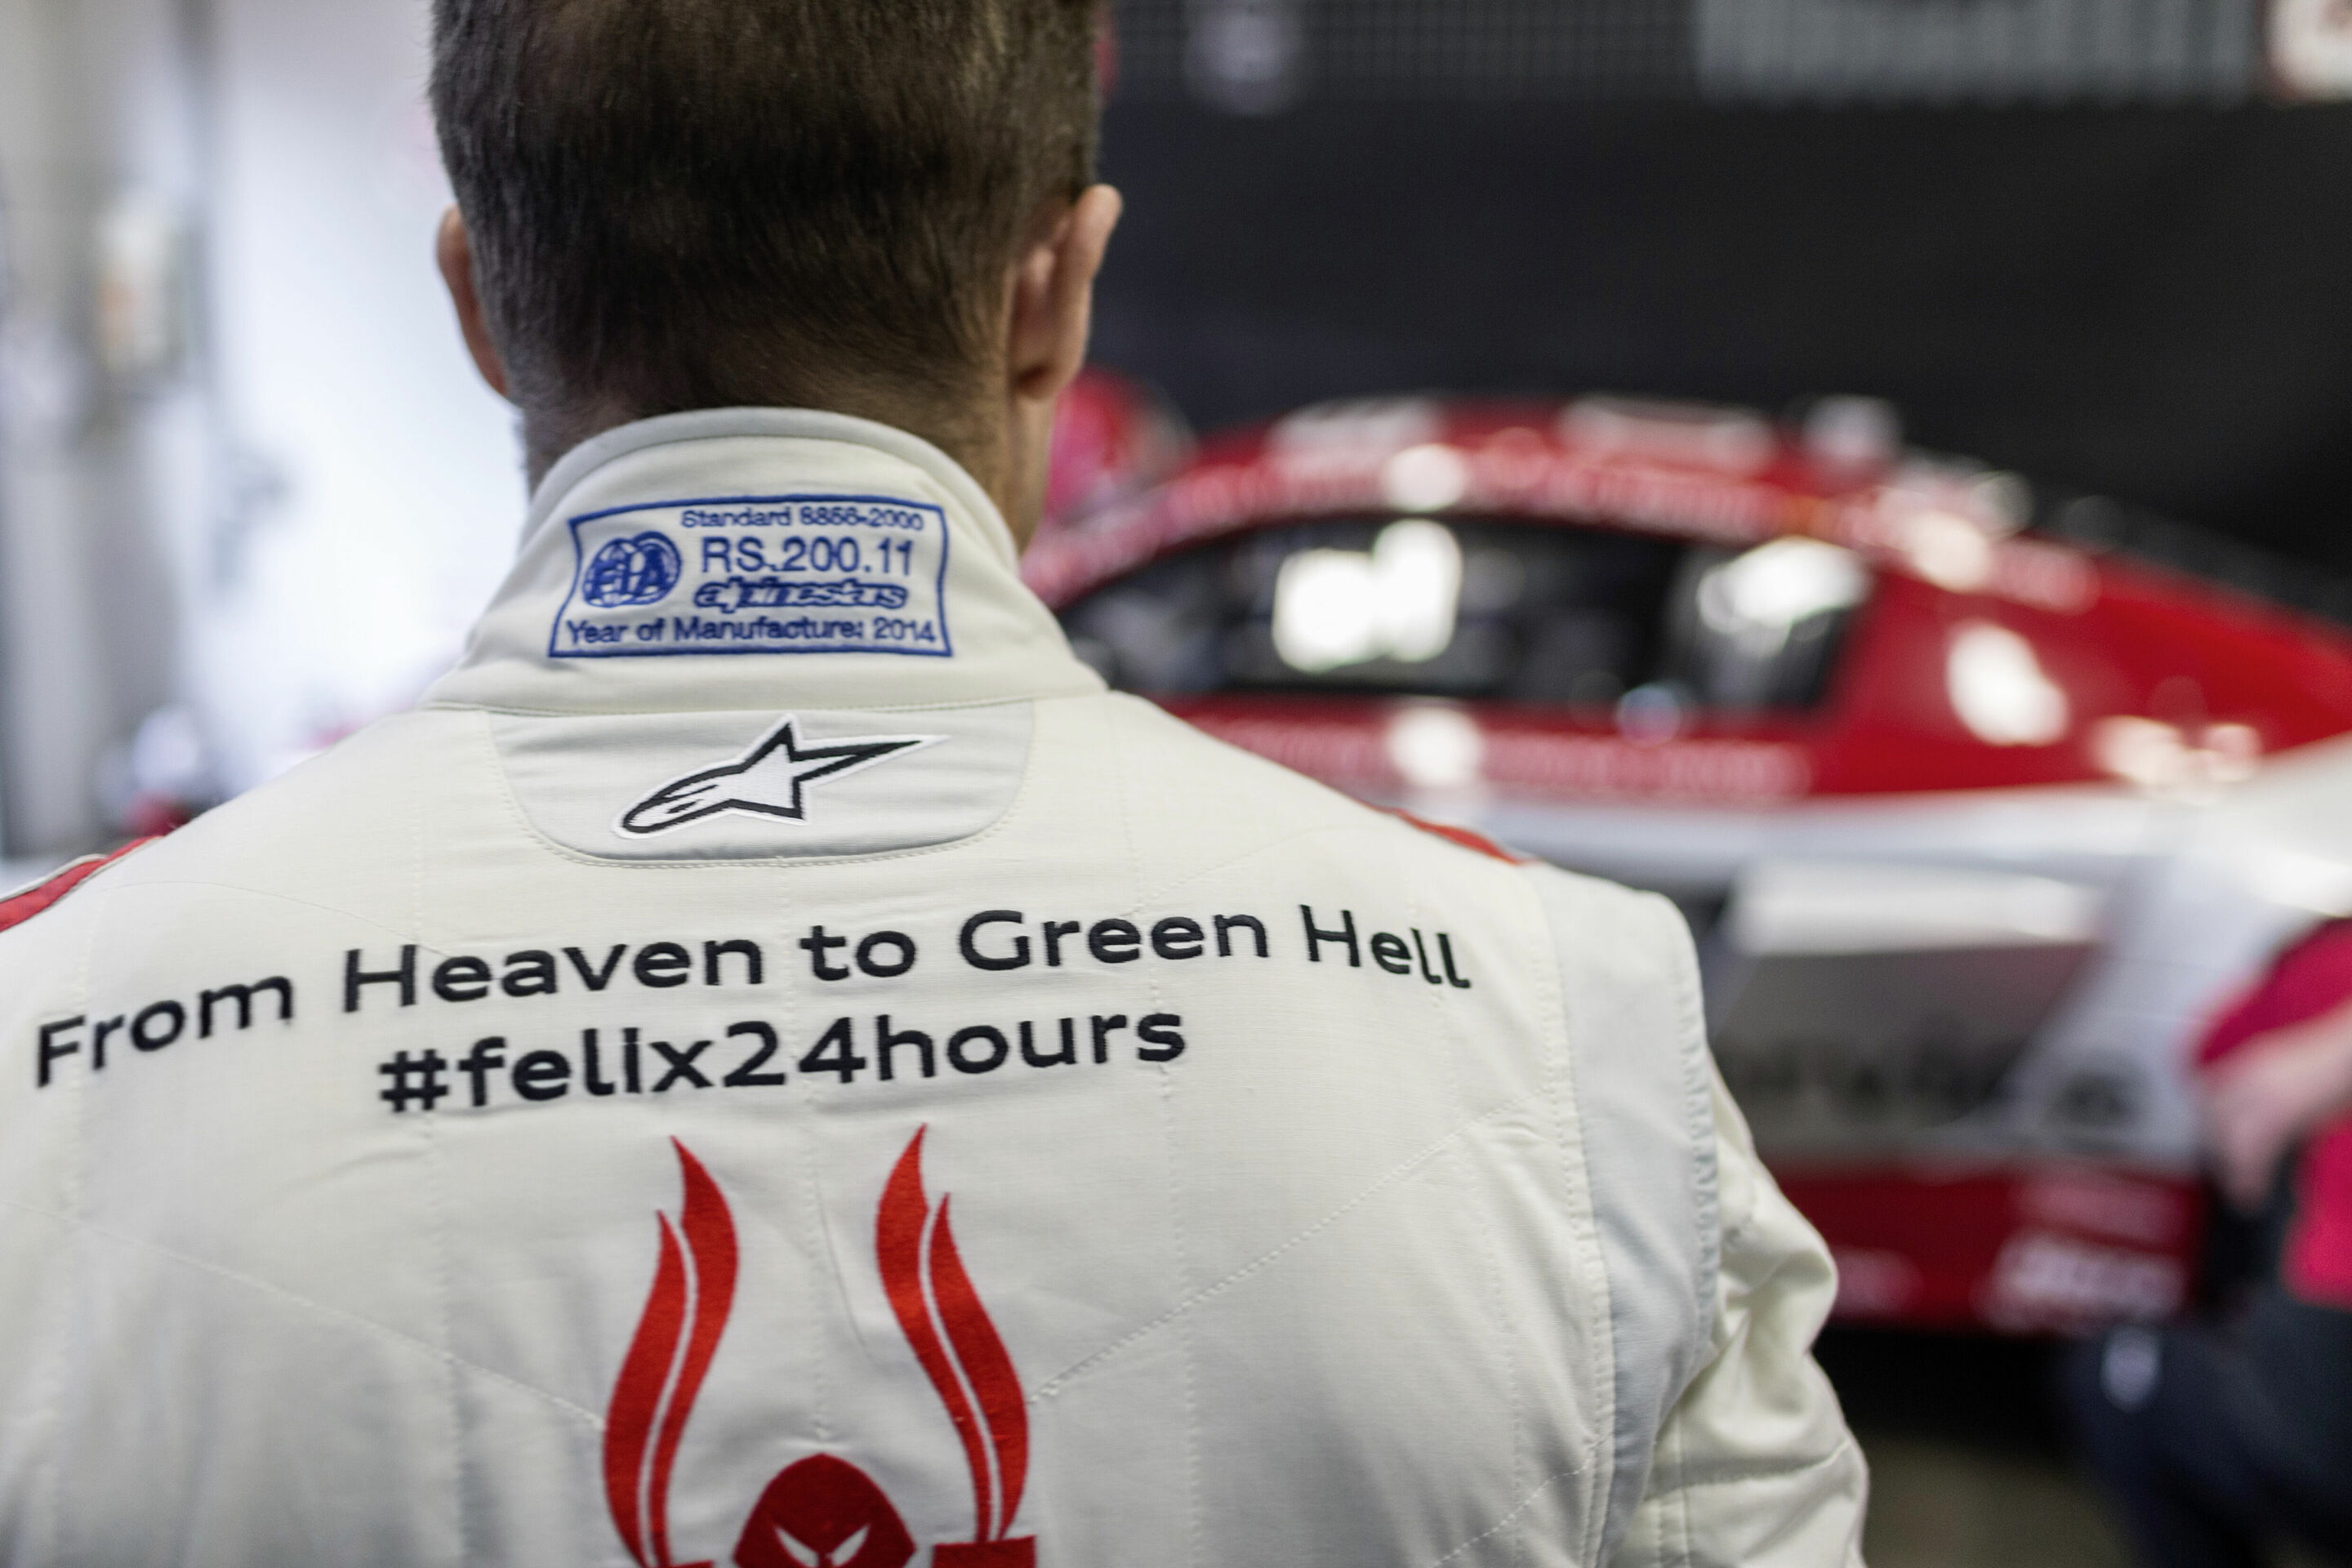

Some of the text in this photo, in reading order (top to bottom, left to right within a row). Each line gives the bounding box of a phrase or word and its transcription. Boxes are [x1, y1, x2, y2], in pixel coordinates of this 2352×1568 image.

[681, 507, 791, 528] Standard
[702, 536, 912, 575] RS.200.11
[566, 615, 936, 644] Year of Manufacture: 2014
[37, 904, 1472, 1089] From Heaven to Green Hell
[378, 1012, 1186, 1113] #felix24hours
